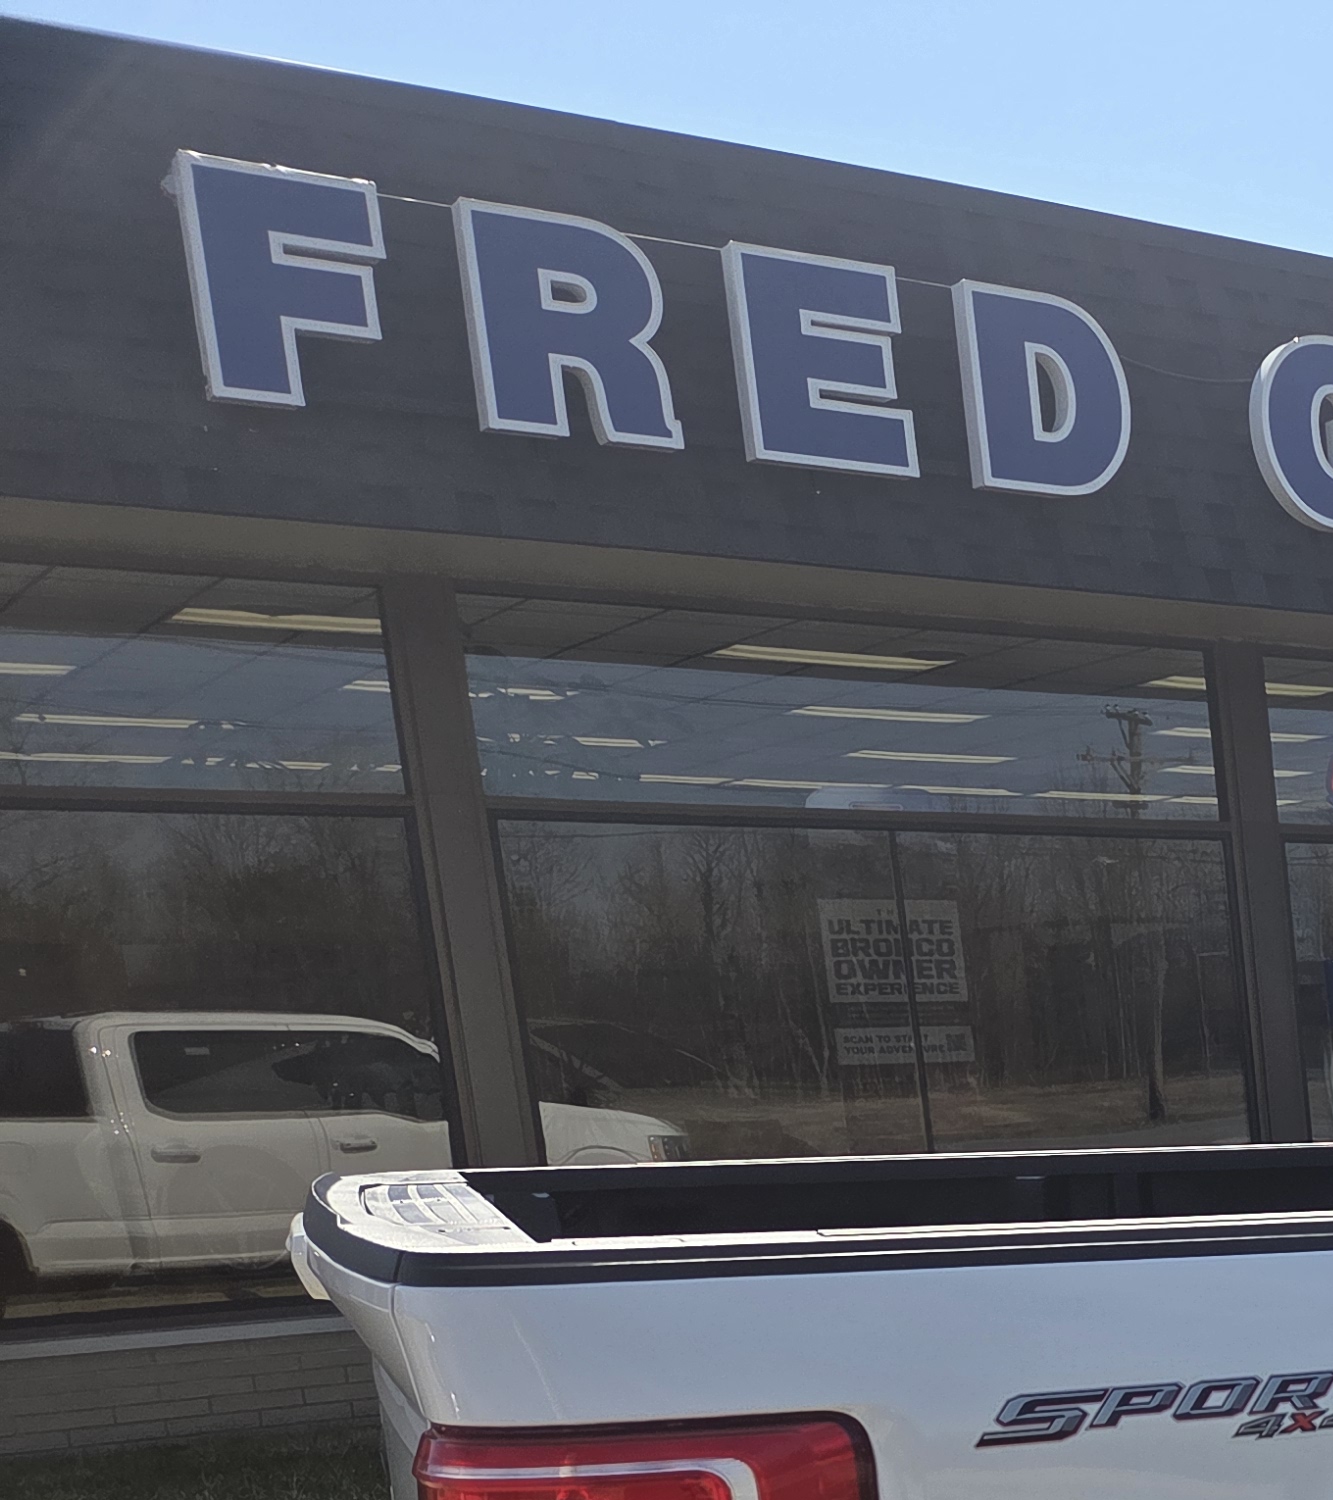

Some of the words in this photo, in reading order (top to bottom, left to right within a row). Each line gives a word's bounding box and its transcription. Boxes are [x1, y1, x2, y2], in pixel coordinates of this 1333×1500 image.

[175, 149, 1131, 496] FRED
[843, 1035, 873, 1044] SCAN
[876, 1034, 891, 1044] TO
[895, 1034, 929, 1044] STAT
[843, 1045, 875, 1055] YOUR
[878, 1044, 945, 1055] ADVEURE
